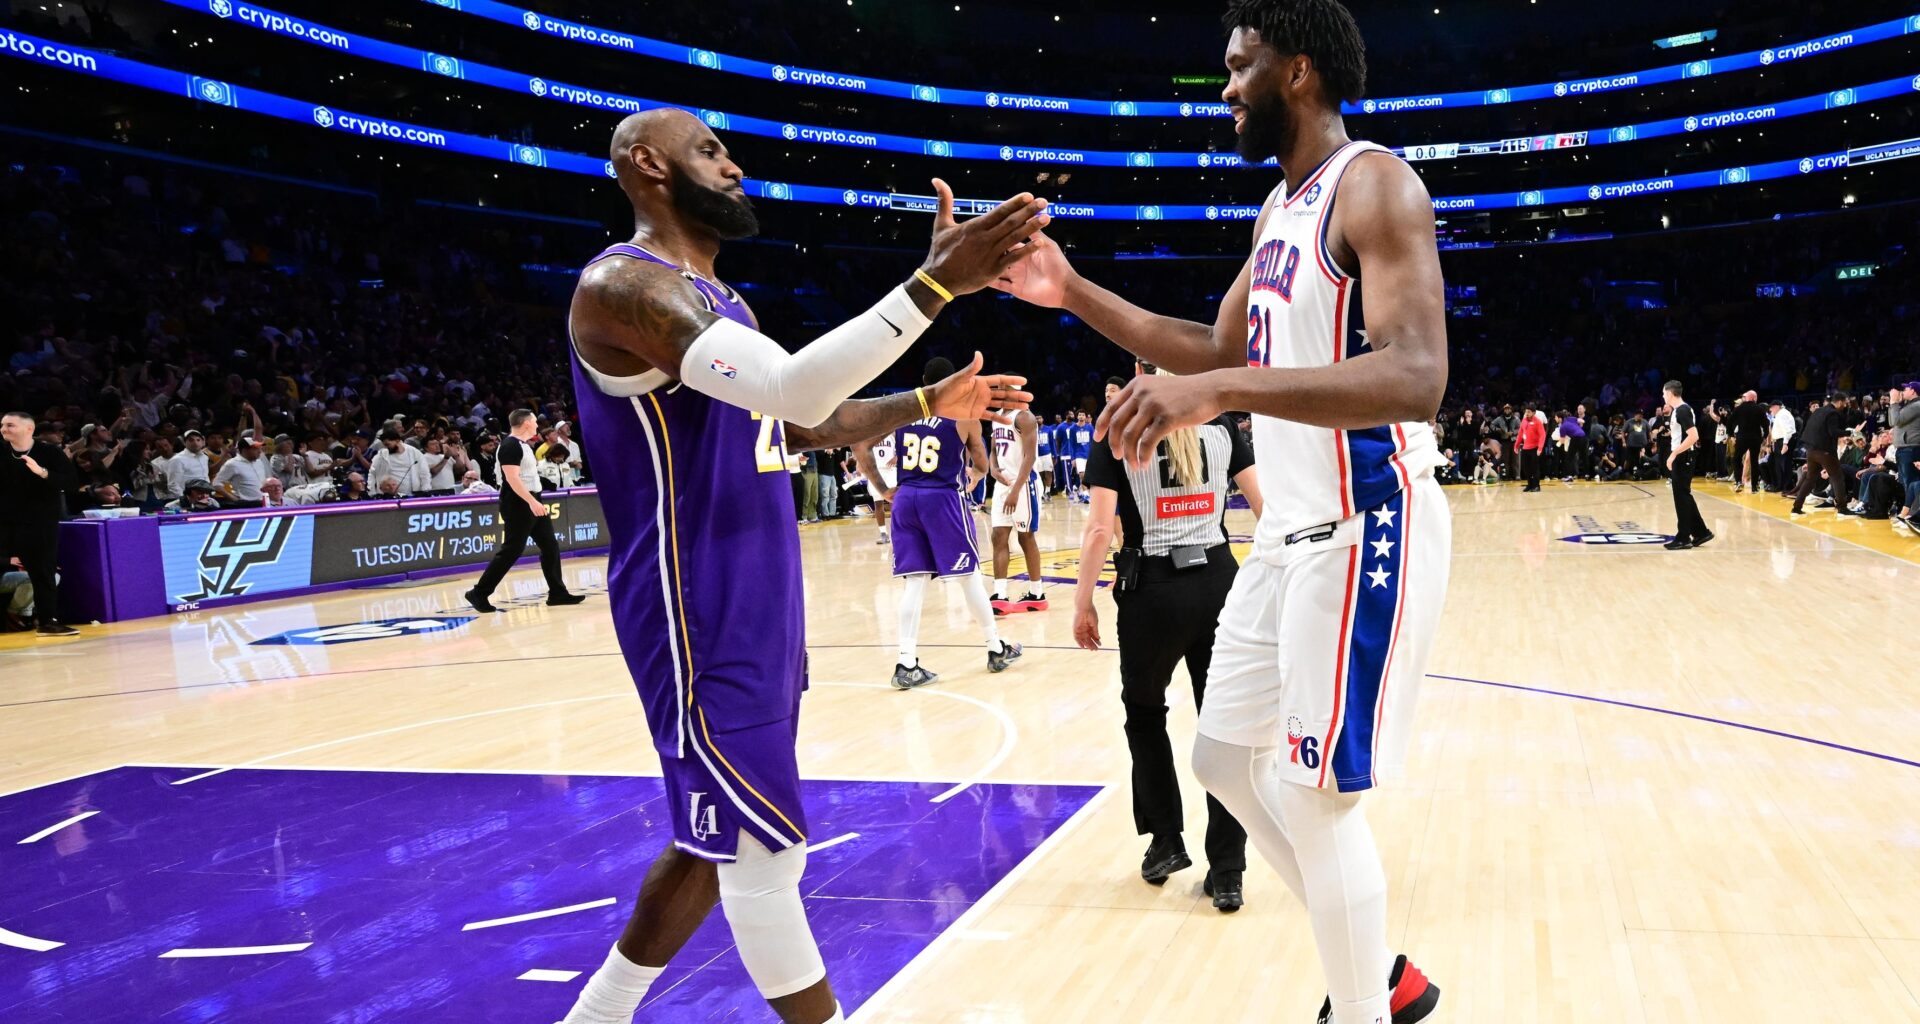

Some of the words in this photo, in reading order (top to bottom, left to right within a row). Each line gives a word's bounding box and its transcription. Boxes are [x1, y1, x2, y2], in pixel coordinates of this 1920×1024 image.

[238, 5, 350, 49] crypto.com
[544, 18, 634, 49] crypto.com
[1777, 33, 1853, 60] crypto.com
[790, 69, 866, 90] crypto.com
[1570, 75, 1638, 94] crypto.com
[550, 84, 640, 112] crypto.com
[1002, 96, 1069, 110] crypto.com
[1378, 96, 1442, 112] crypto.com
[1701, 107, 1776, 127] crypto.com
[338, 114, 446, 146] crypto.com
[801, 127, 877, 146] crypto.com
[1016, 148, 1084, 163] crypto.com
[1415, 148, 1436, 159] 0.0
[1505, 140, 1528, 152] 115
[1604, 178, 1673, 196] crypto.com
[1248, 304, 1271, 368] 21
[750, 411, 792, 473] 2
[879, 449, 885, 457] 0
[903, 433, 941, 473] 36
[1162, 500, 1210, 513] Emirates
[407, 510, 472, 533] SPURS
[478, 514, 493, 526] VS
[575, 529, 587, 542] NBA
[588, 528, 599, 541] APP
[352, 540, 436, 568] TUESDAY
[449, 535, 483, 556] 7:30
[483, 534, 496, 543] PM
[484, 542, 494, 552] PT
[176, 602, 200, 611] anc
[1287, 731, 1320, 769] 76
[687, 791, 722, 842] LA
